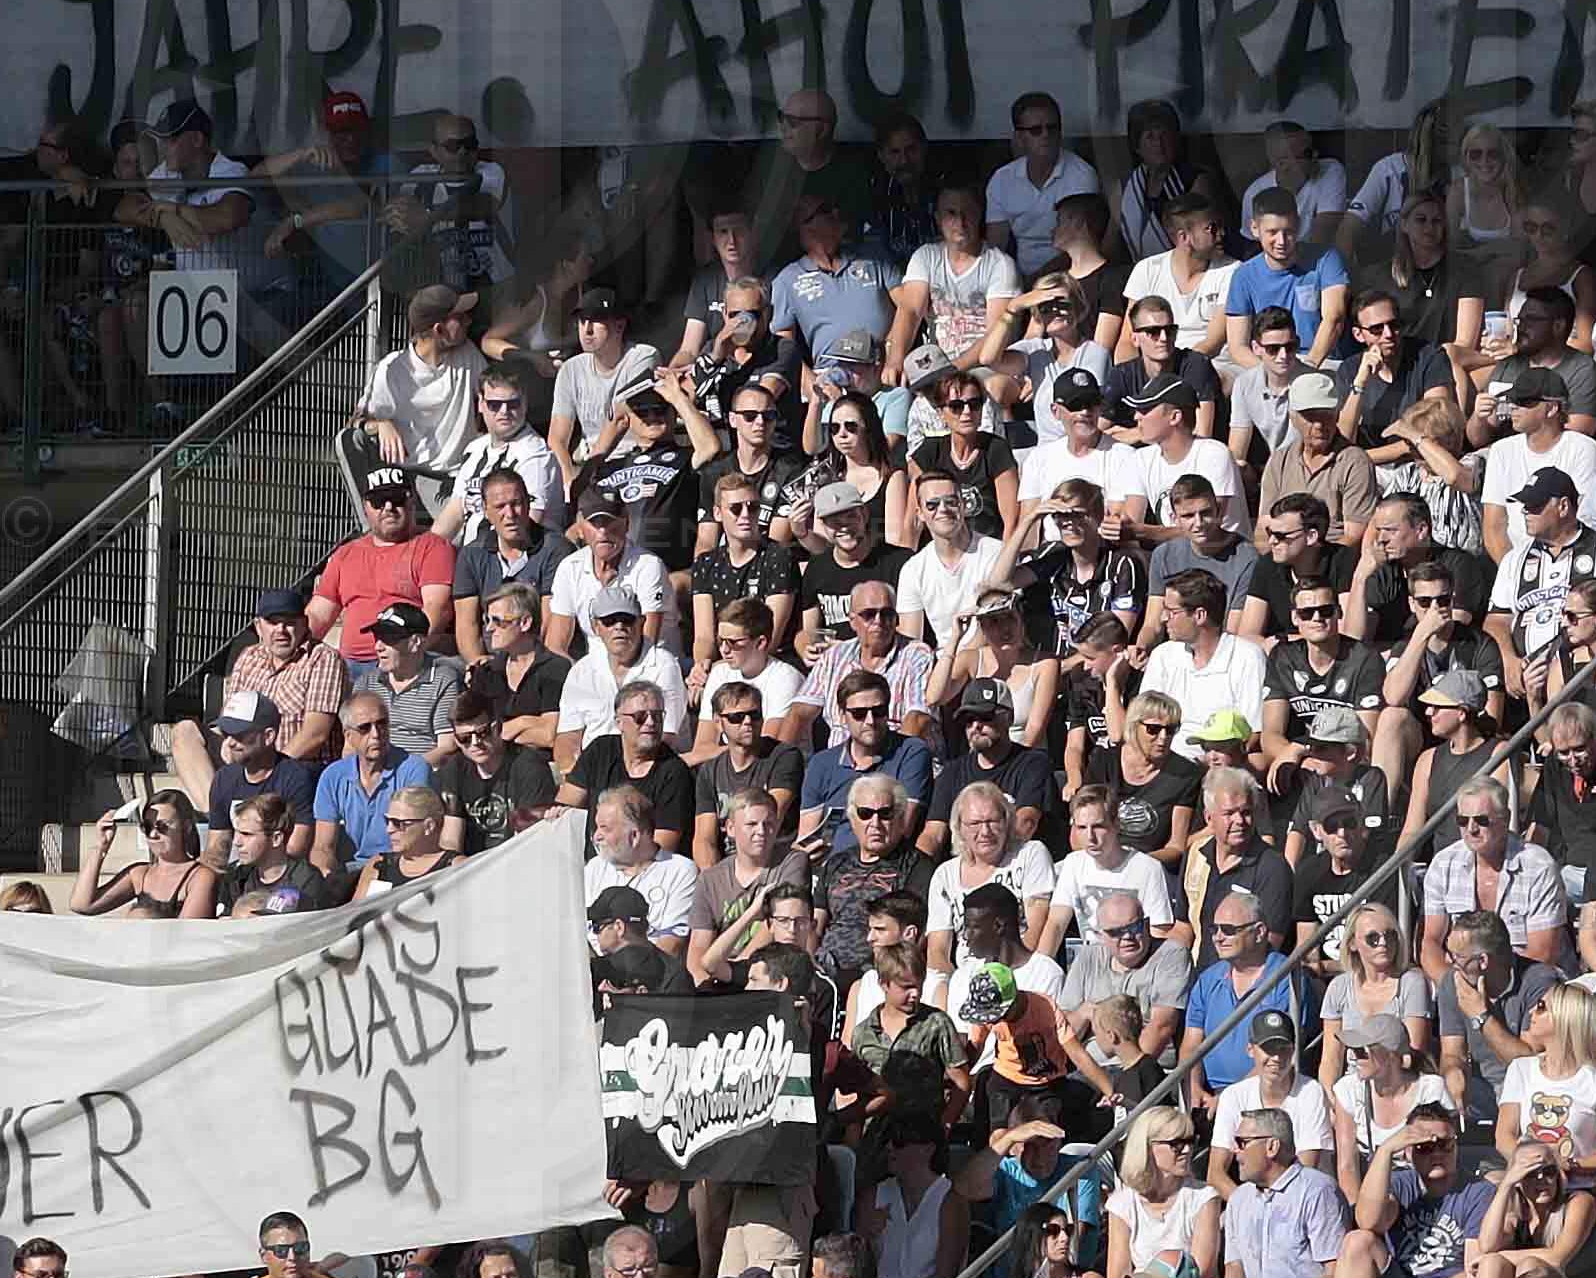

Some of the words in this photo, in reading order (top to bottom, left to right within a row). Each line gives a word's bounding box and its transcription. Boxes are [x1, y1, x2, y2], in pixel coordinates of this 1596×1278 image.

[156, 284, 230, 360] 06
[367, 466, 405, 491] NYC
[288, 1068, 442, 1212] BG
